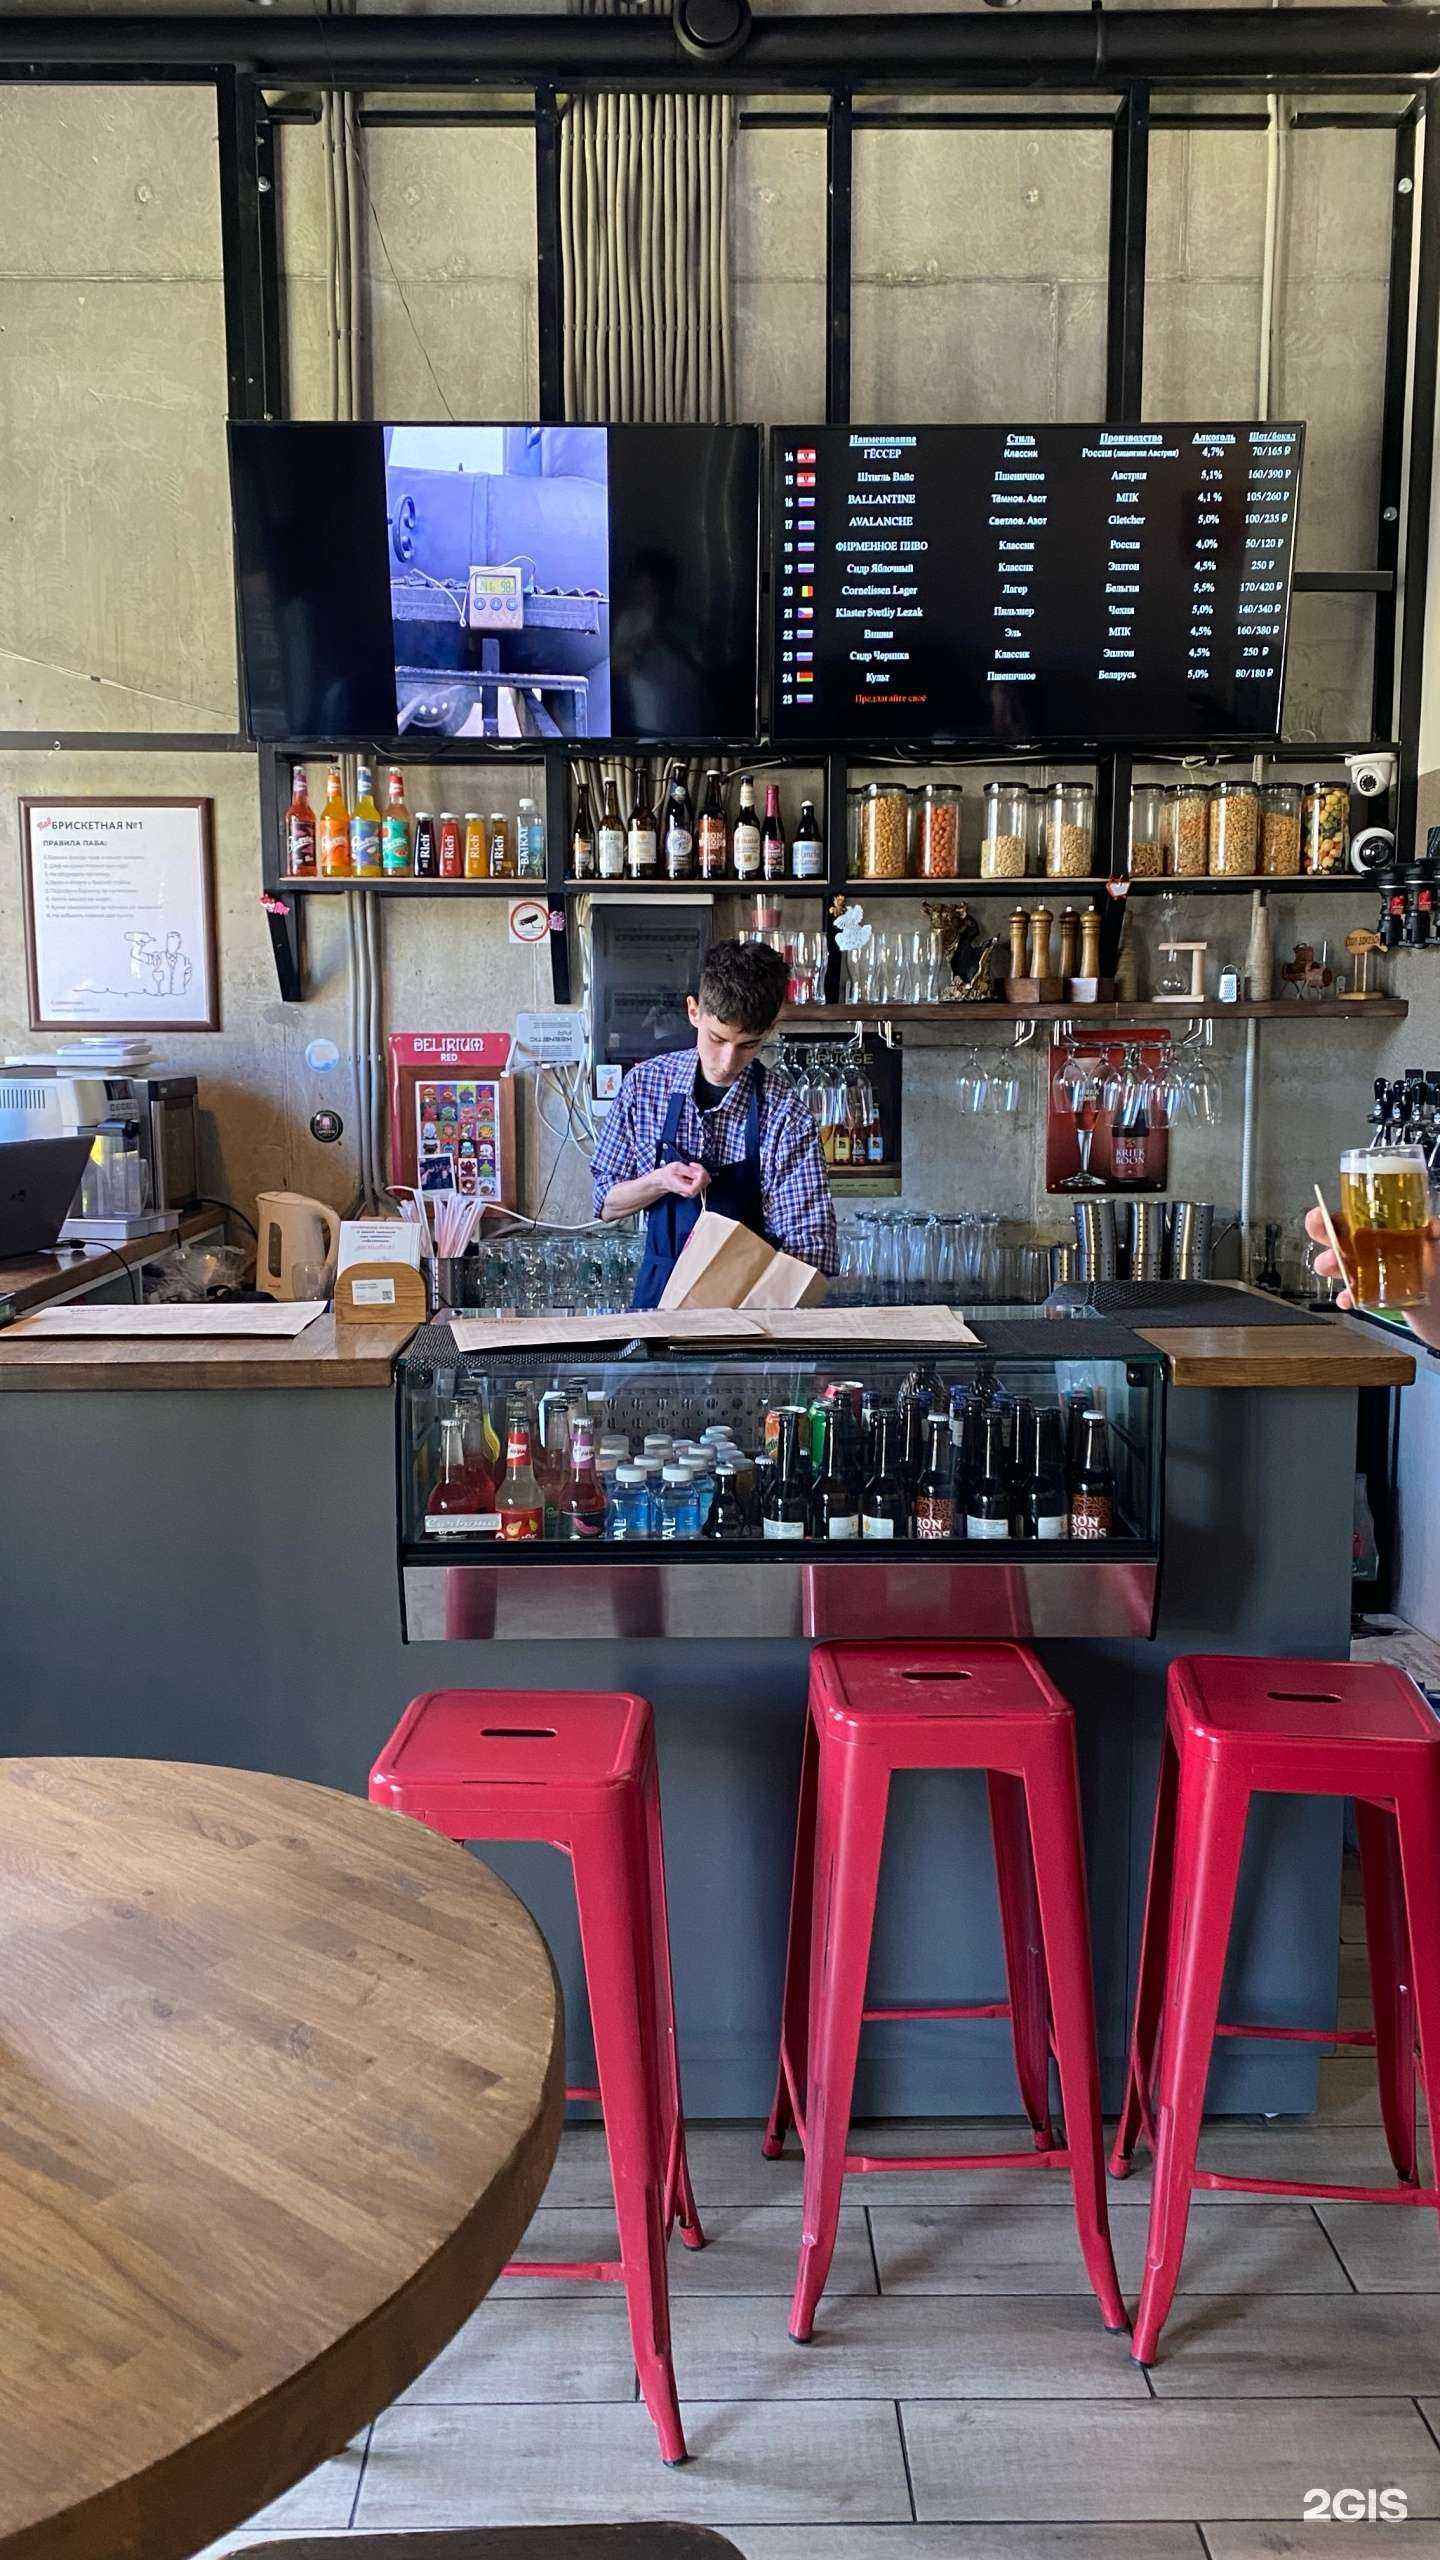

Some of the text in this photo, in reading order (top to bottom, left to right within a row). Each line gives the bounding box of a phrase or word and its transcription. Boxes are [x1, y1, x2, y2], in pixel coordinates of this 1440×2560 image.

[1006, 434, 1036, 446] Стиль
[1099, 432, 1163, 445] Производство
[1191, 432, 1236, 444] Алкоголь
[785, 451, 794, 463] 14
[864, 449, 901, 459] ГЁССЕР
[1003, 449, 1038, 458] Классик
[1082, 448, 1113, 457] Россия
[1202, 447, 1224, 457] 4,7%
[1252, 447, 1284, 457] 70/165
[785, 475, 794, 486] 15
[995, 471, 1045, 481] Пшеничное
[1111, 471, 1147, 483] Австрия
[1201, 470, 1222, 480] 5,1%
[1249, 469, 1283, 480] 160/390
[785, 497, 794, 508] 16
[848, 494, 915, 504] BALLANTINE
[1027, 494, 1048, 503] Азот
[1247, 492, 1281, 502] 105/260
[784, 520, 793, 530] 17
[849, 517, 913, 527] AVALANCHE
[1027, 516, 1048, 525] Азот
[1108, 515, 1145, 525] Gletcher
[1198, 514, 1219, 525] 5,0%
[1245, 514, 1280, 524] 100/235
[836, 541, 898, 552] ФИРМЕННОЕ
[899, 541, 928, 550] ПИВО
[999, 541, 1034, 550] Классик
[1110, 540, 1140, 549] Россия
[1196, 539, 1218, 549] 4,0%
[1245, 538, 1276, 549] 50/120
[847, 564, 870, 576] Сидр
[871, 563, 913, 574] Яблочный
[998, 563, 1033, 572] Классик
[1194, 561, 1216, 571] 4,5%
[1250, 560, 1268, 570] 250
[783, 587, 793, 597] 20
[842, 585, 891, 595] Cornelissen
[893, 586, 917, 597] Lager
[1002, 584, 1028, 595] Лагер
[1105, 583, 1139, 593] Бельгия
[1193, 583, 1215, 593] 5,5%
[1240, 582, 1275, 592] 170/420
[835, 607, 867, 618] Klaster
[897, 607, 923, 617] Lezak
[1108, 606, 1134, 615] Чехия
[1192, 605, 1213, 615] 5,0%
[1238, 604, 1273, 614] 140/340
[783, 630, 793, 640] 22
[1005, 628, 1022, 637] Эль
[1108, 627, 1131, 637] МПК
[1190, 626, 1212, 636] 4,5%
[849, 651, 872, 662] Сидр
[873, 651, 910, 662] Черника
[995, 650, 1030, 659] Классик
[1189, 648, 1210, 658] 4,5%
[1243, 647, 1259, 657] 250
[987, 672, 1036, 681] Пшеничное
[1099, 670, 1137, 681] Беларусь
[1187, 669, 1209, 679] 5,0%
[1235, 668, 1266, 679] 80/180
[52, 821, 144, 830] БРИСКЕТНАЯ №1
[420, 833, 430, 859] Rich
[445, 834, 454, 859] Rich
[470, 835, 480, 859] Rich
[494, 834, 504, 859] Rich
[413, 1038, 484, 1052] DELIRIUM
[440, 1053, 458, 1062] RED
[917, 1517, 942, 1529] RON
[1072, 1514, 1099, 1527] RON
[613, 1518, 627, 1540] AL
[662, 1517, 676, 1540] AL
